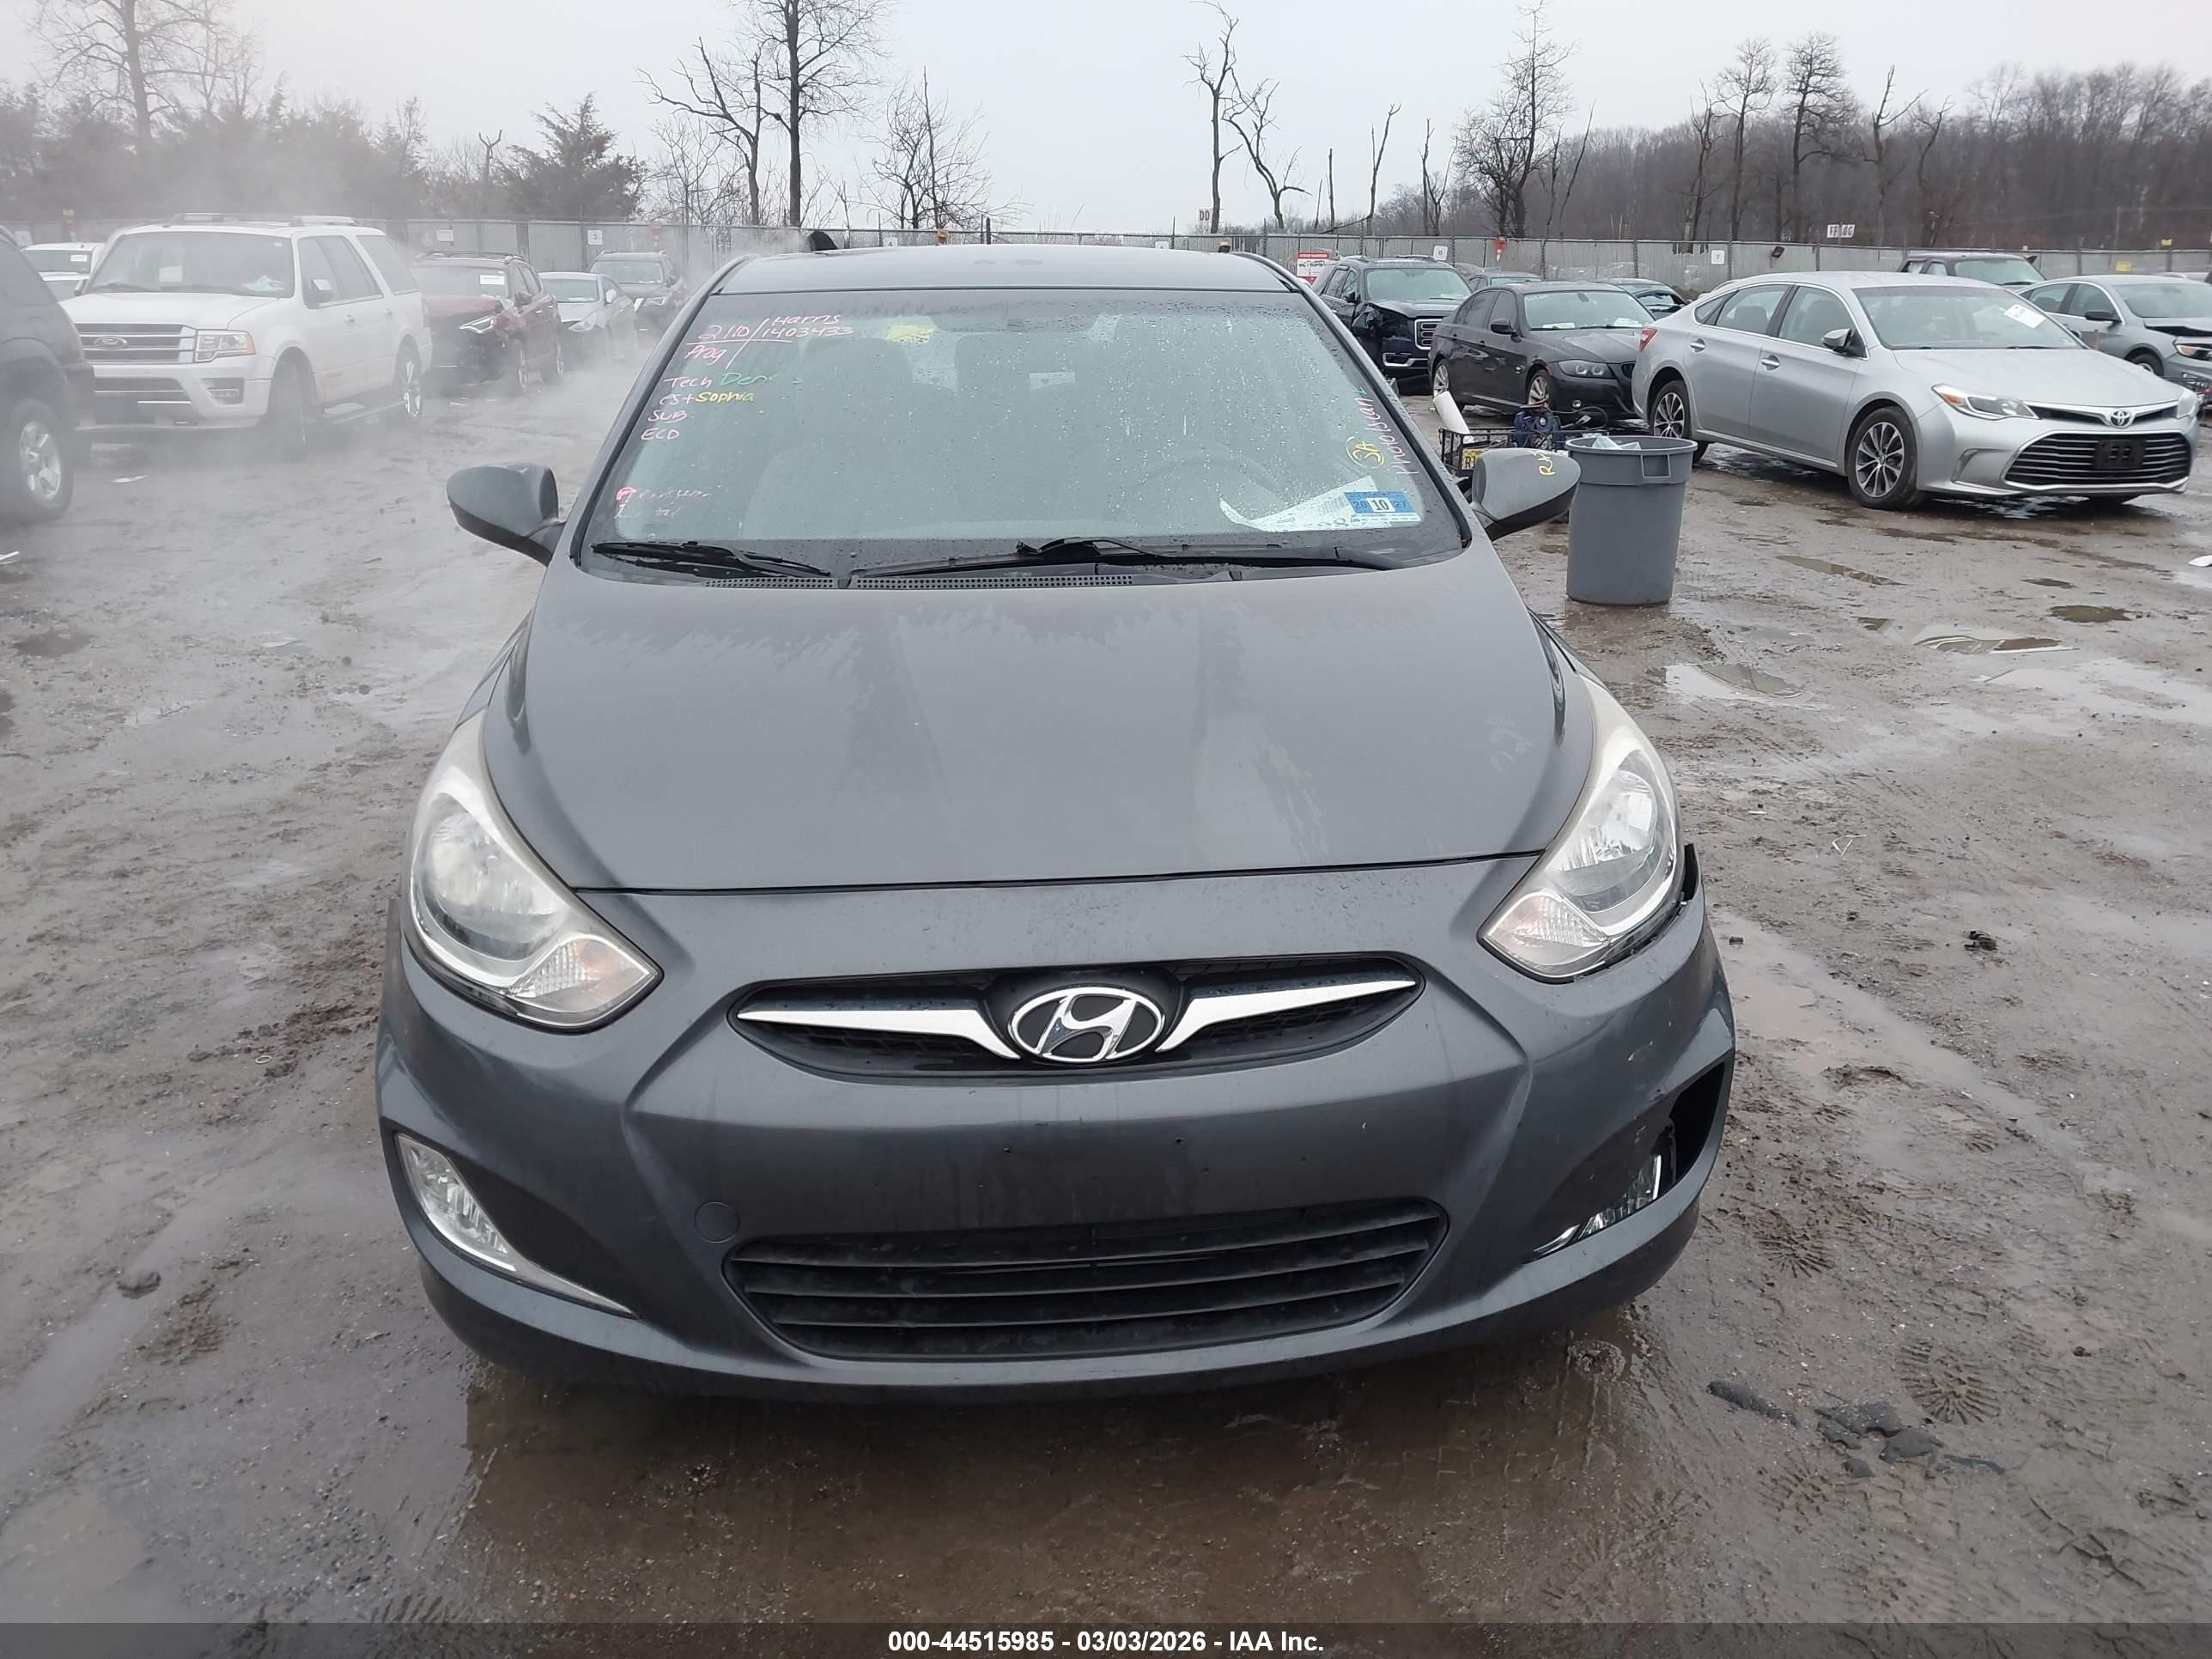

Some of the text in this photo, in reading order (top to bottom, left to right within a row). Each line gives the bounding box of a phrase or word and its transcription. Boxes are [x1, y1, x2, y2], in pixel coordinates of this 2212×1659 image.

[1199, 210, 1211, 222] DD
[1352, 499, 1407, 511] 20 10 27
